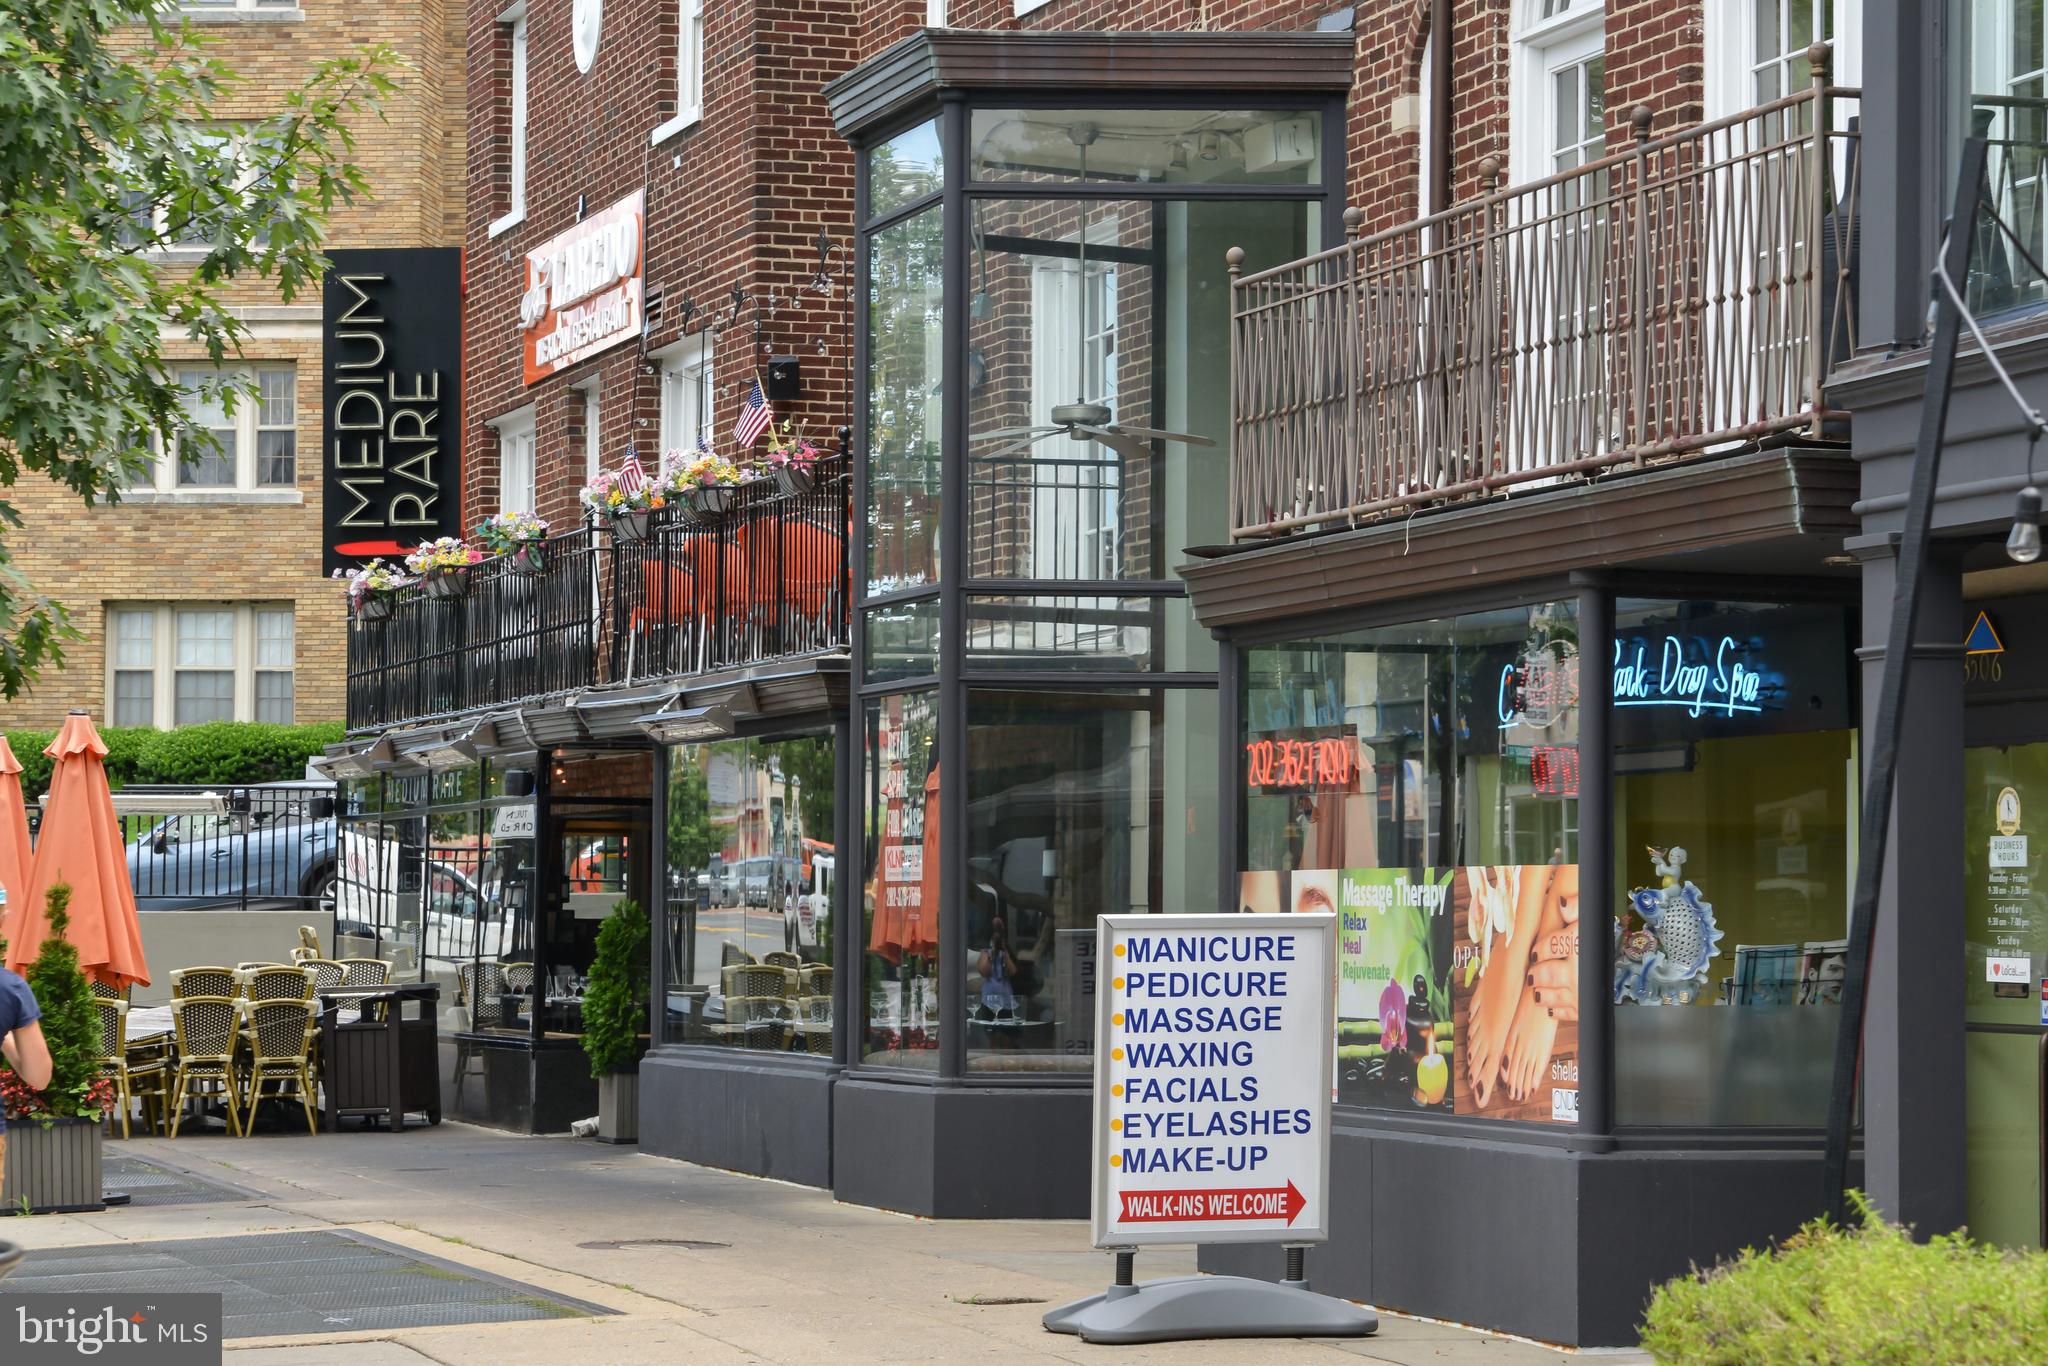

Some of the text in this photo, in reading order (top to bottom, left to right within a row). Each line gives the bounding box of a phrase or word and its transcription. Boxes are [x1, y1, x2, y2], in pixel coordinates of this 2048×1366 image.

[335, 273, 387, 527] MEDIUM
[389, 368, 439, 526] RARE
[1660, 635, 1708, 718] Day
[1713, 636, 1760, 717] Spa
[386, 771, 462, 803] MEDIUM RARE
[1343, 876, 1447, 916] Massage Therapy
[1343, 912, 1367, 931] Relax
[1994, 904, 2022, 915] Saturday
[1127, 937, 1295, 962] MANICURE
[1343, 936, 1361, 954] Heal
[1997, 936, 2020, 947] Sunday
[1126, 972, 1287, 998] PEDICURE
[1343, 961, 1390, 984] Rejuvenate
[1125, 1006, 1282, 1033] MASSAGE
[1126, 1042, 1253, 1068] WAXING
[1125, 1077, 1258, 1103] FACIALS
[1123, 1109, 1311, 1138] EYELASHES
[1122, 1146, 1268, 1173] MAKE-UP
[1127, 1193, 1288, 1217] WALK-INS WELCOME
